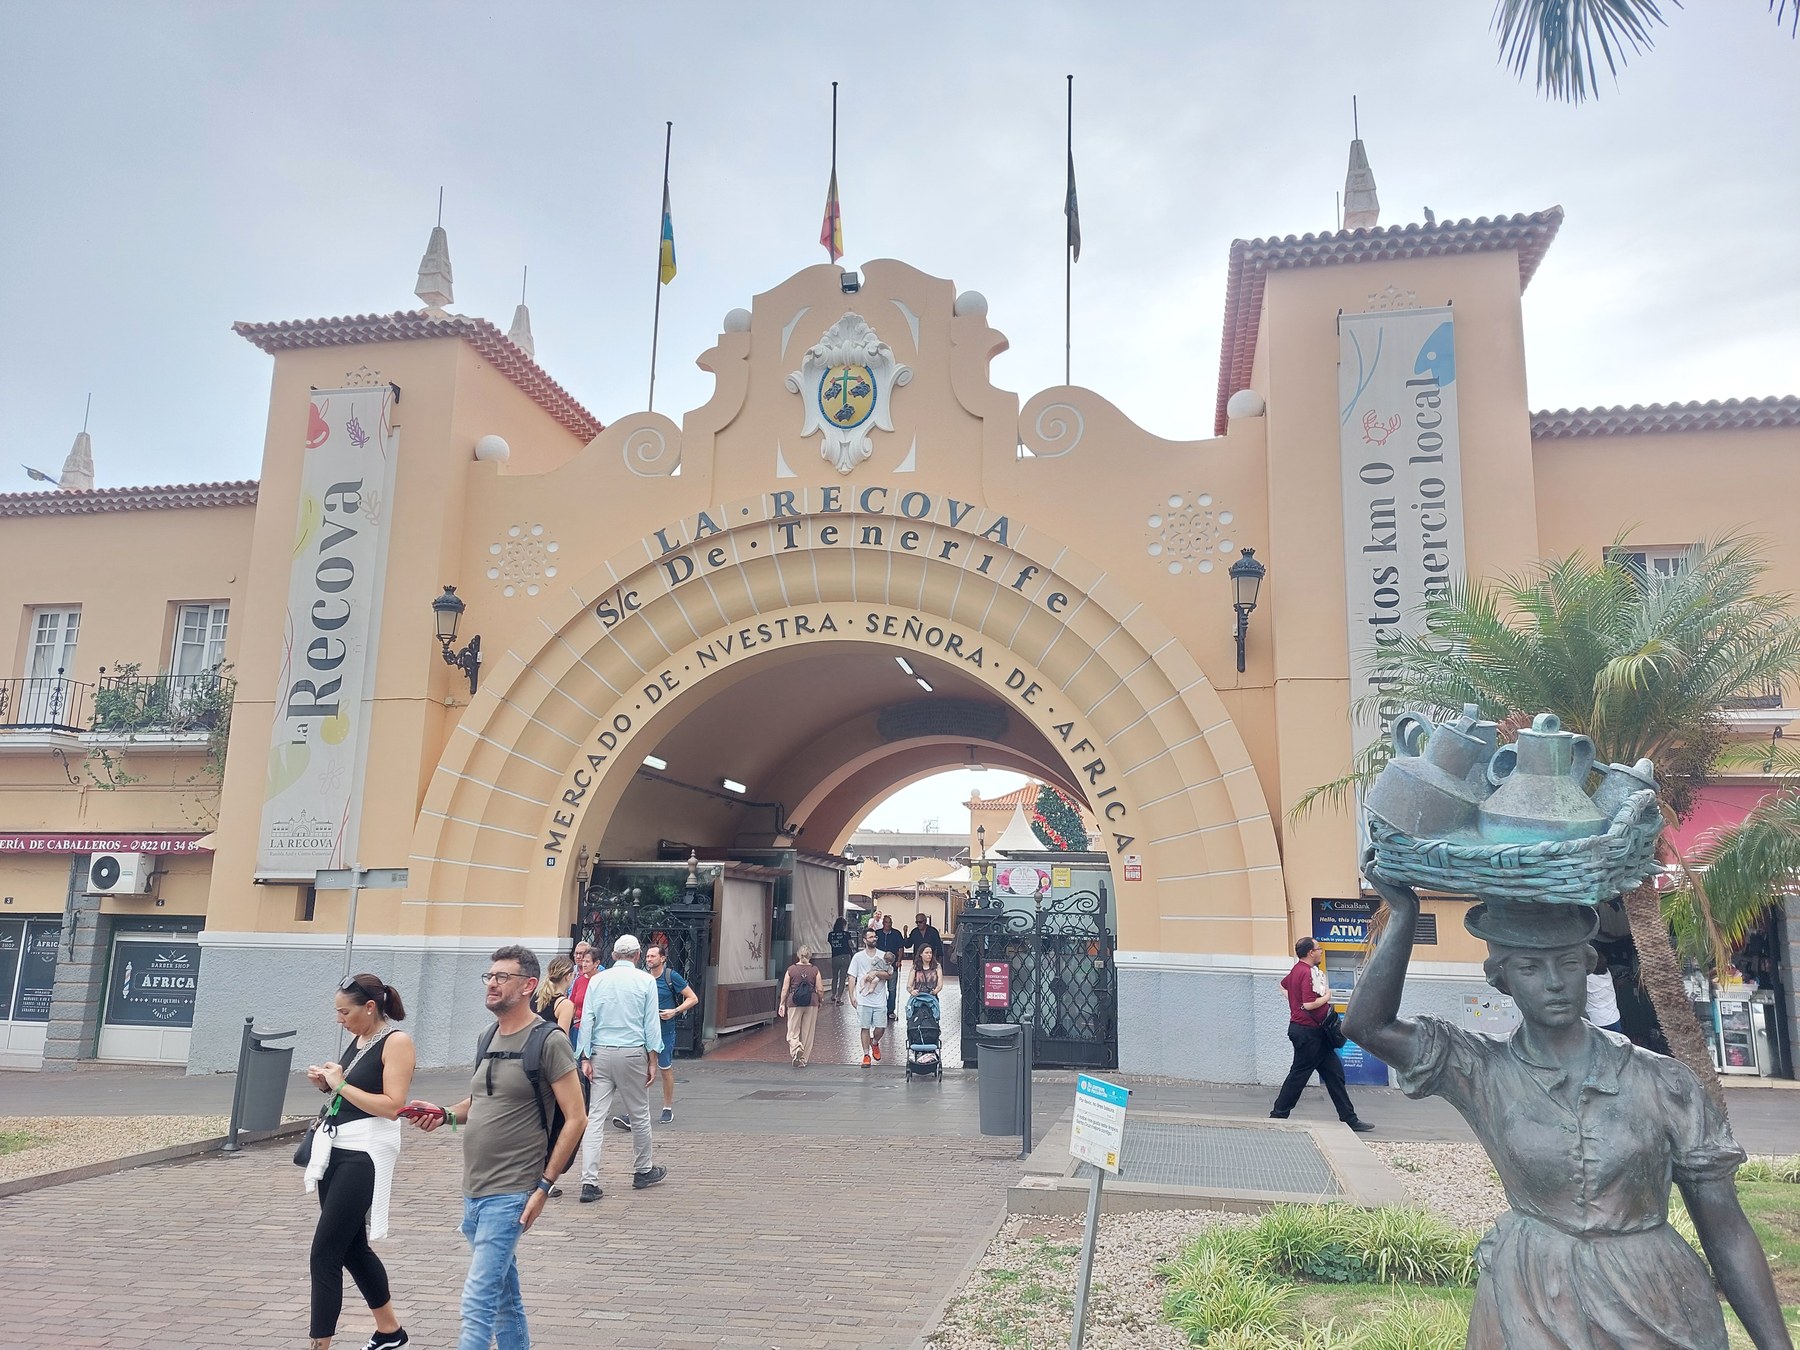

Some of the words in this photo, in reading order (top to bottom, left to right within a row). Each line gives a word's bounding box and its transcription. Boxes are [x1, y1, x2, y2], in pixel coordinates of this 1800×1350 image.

[1405, 373, 1444, 466] local
[653, 511, 722, 556] LA
[770, 486, 1010, 548] RECOVA
[1362, 496, 1399, 554] km
[595, 589, 642, 628] S/c
[662, 547, 727, 587] De
[778, 520, 1068, 613] Tenerife
[286, 477, 364, 721] Recova
[291, 722, 308, 745] La
[544, 713, 632, 853] MERCADO
[643, 669, 680, 704] DE
[696, 613, 838, 668] NVESTRA
[865, 613, 983, 668] SEÑORA
[1005, 667, 1043, 705] DE
[1052, 722, 1135, 854] AFRICA
[29, 840, 45, 850] DE
[47, 839, 121, 850] CABALLEROS
[140, 841, 158, 850] 822
[160, 841, 171, 850] 01
[174, 841, 186, 850] 34
[270, 839, 284, 848] LA
[288, 839, 333, 848] RECOVA
[1334, 901, 1370, 910] CaixaBank
[1330, 925, 1362, 937] ATM
[142, 973, 195, 988] ÁFRICA
